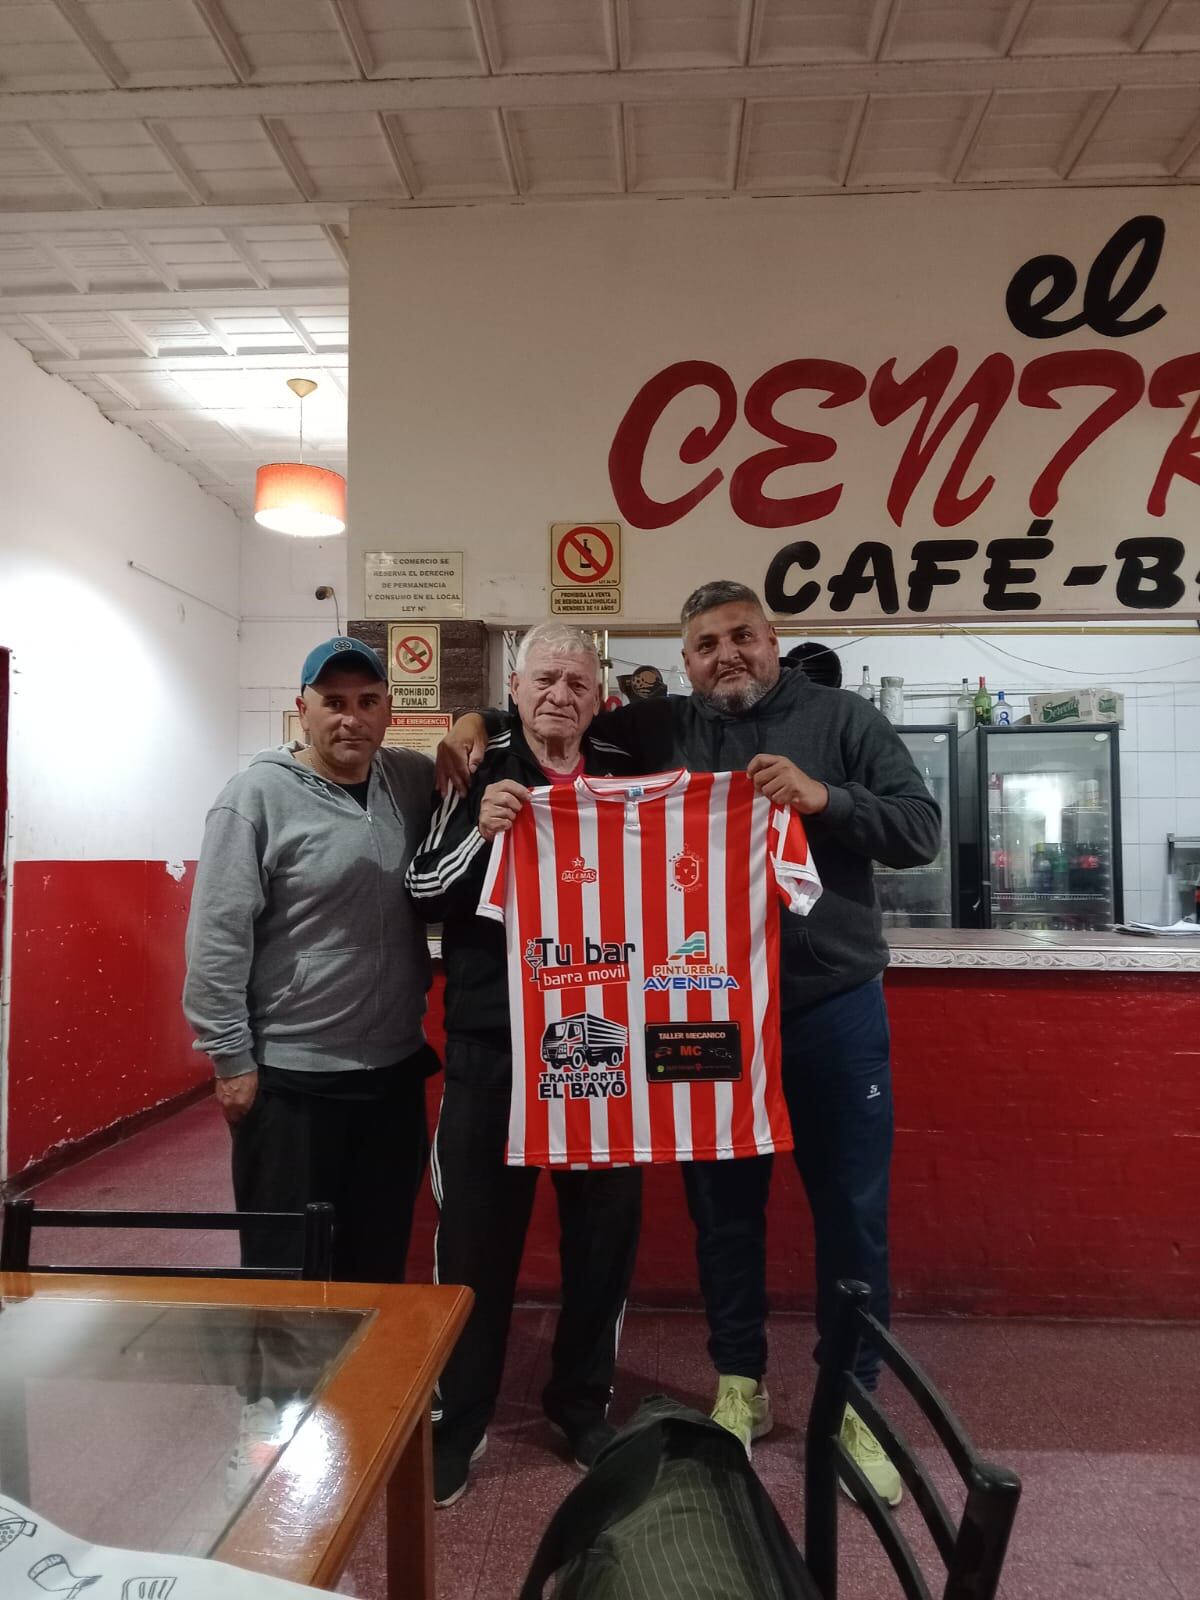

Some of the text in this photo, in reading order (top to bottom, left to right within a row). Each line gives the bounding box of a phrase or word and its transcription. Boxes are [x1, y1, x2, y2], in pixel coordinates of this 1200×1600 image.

[1005, 215, 1167, 339] el
[394, 688, 435, 696] PROHIBIDO
[535, 937, 636, 966] Tu bar
[543, 964, 626, 986] barra movil
[654, 964, 726, 975] PINTURERÍA
[643, 976, 738, 990] AVENIDA
[680, 1046, 702, 1056] MC
[541, 1072, 624, 1082] TRANSPORTE
[540, 1081, 626, 1098] EL BAYO
